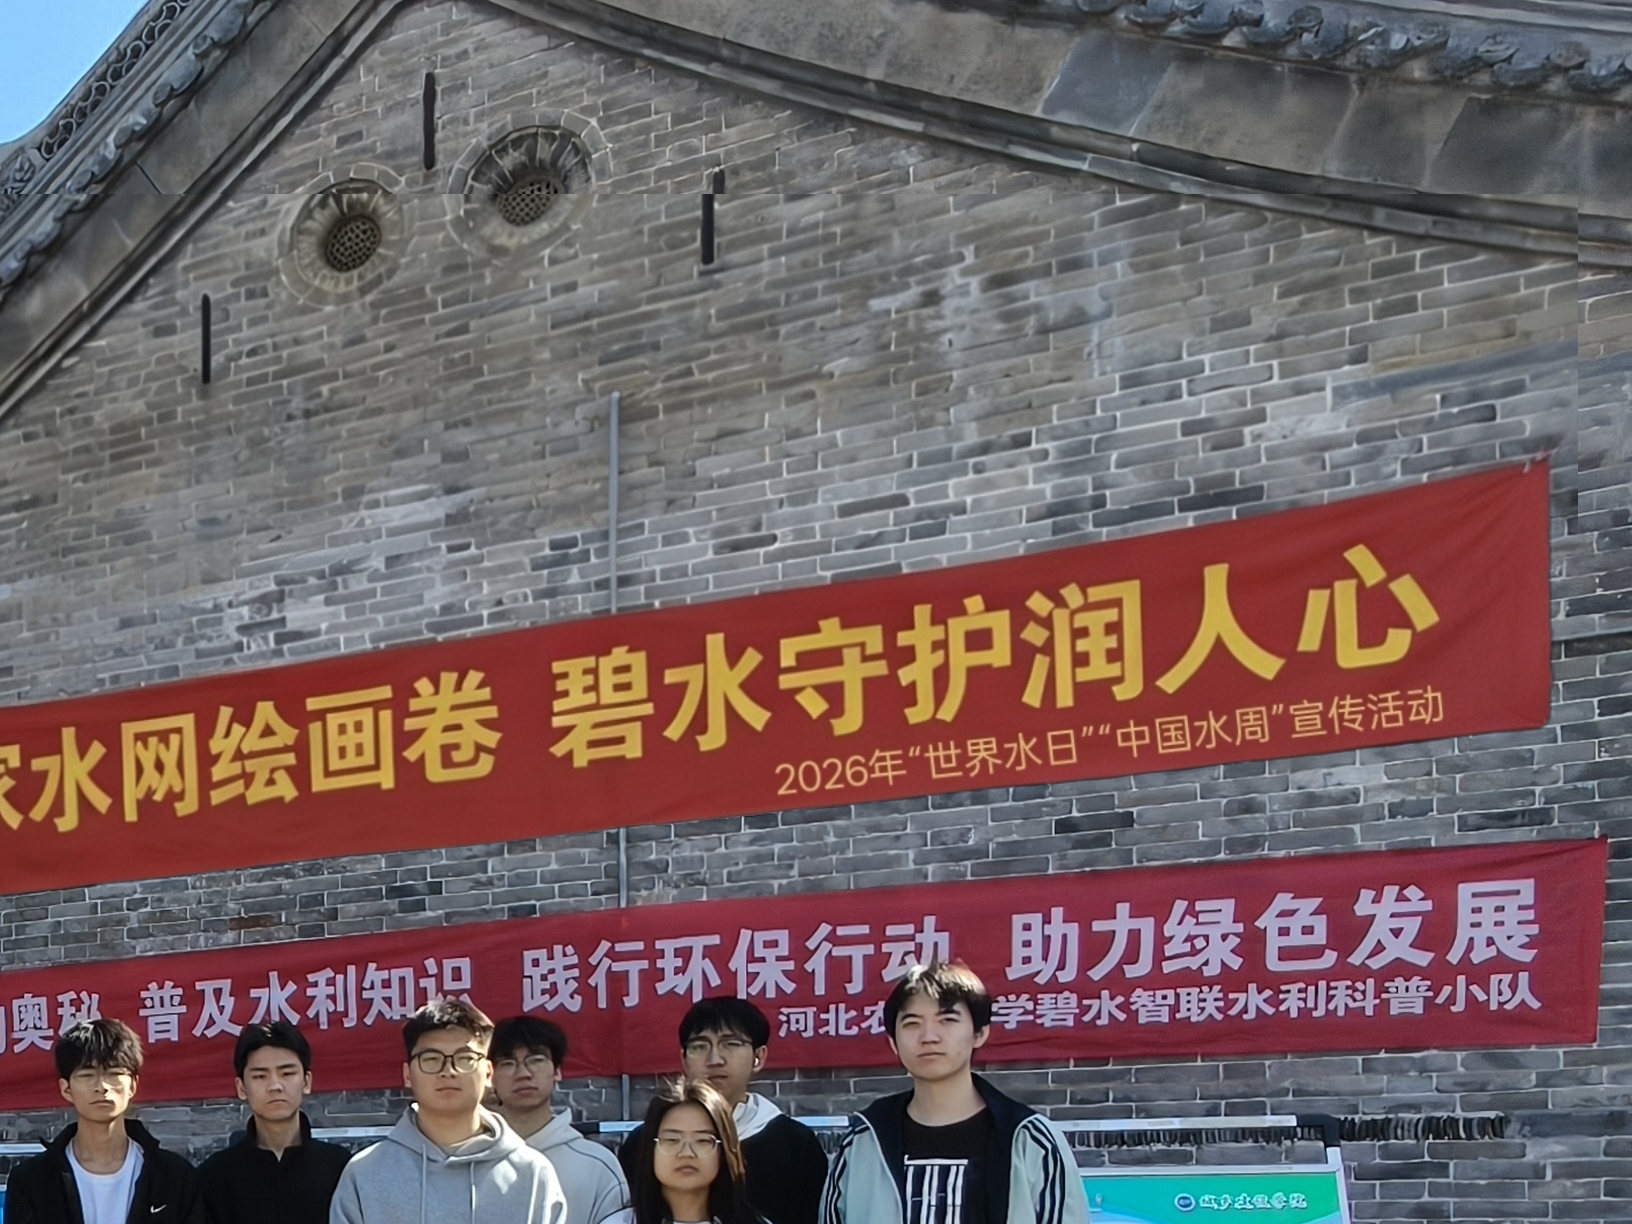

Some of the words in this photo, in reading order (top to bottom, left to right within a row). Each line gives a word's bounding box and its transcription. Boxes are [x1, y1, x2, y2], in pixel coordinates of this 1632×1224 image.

[549, 543, 1441, 768] 碧水守护润人心
[138, 957, 473, 1044] 普及水利知识
[521, 915, 952, 1014] 践行环保行动
[1005, 878, 1541, 985] 助力绿色发展
